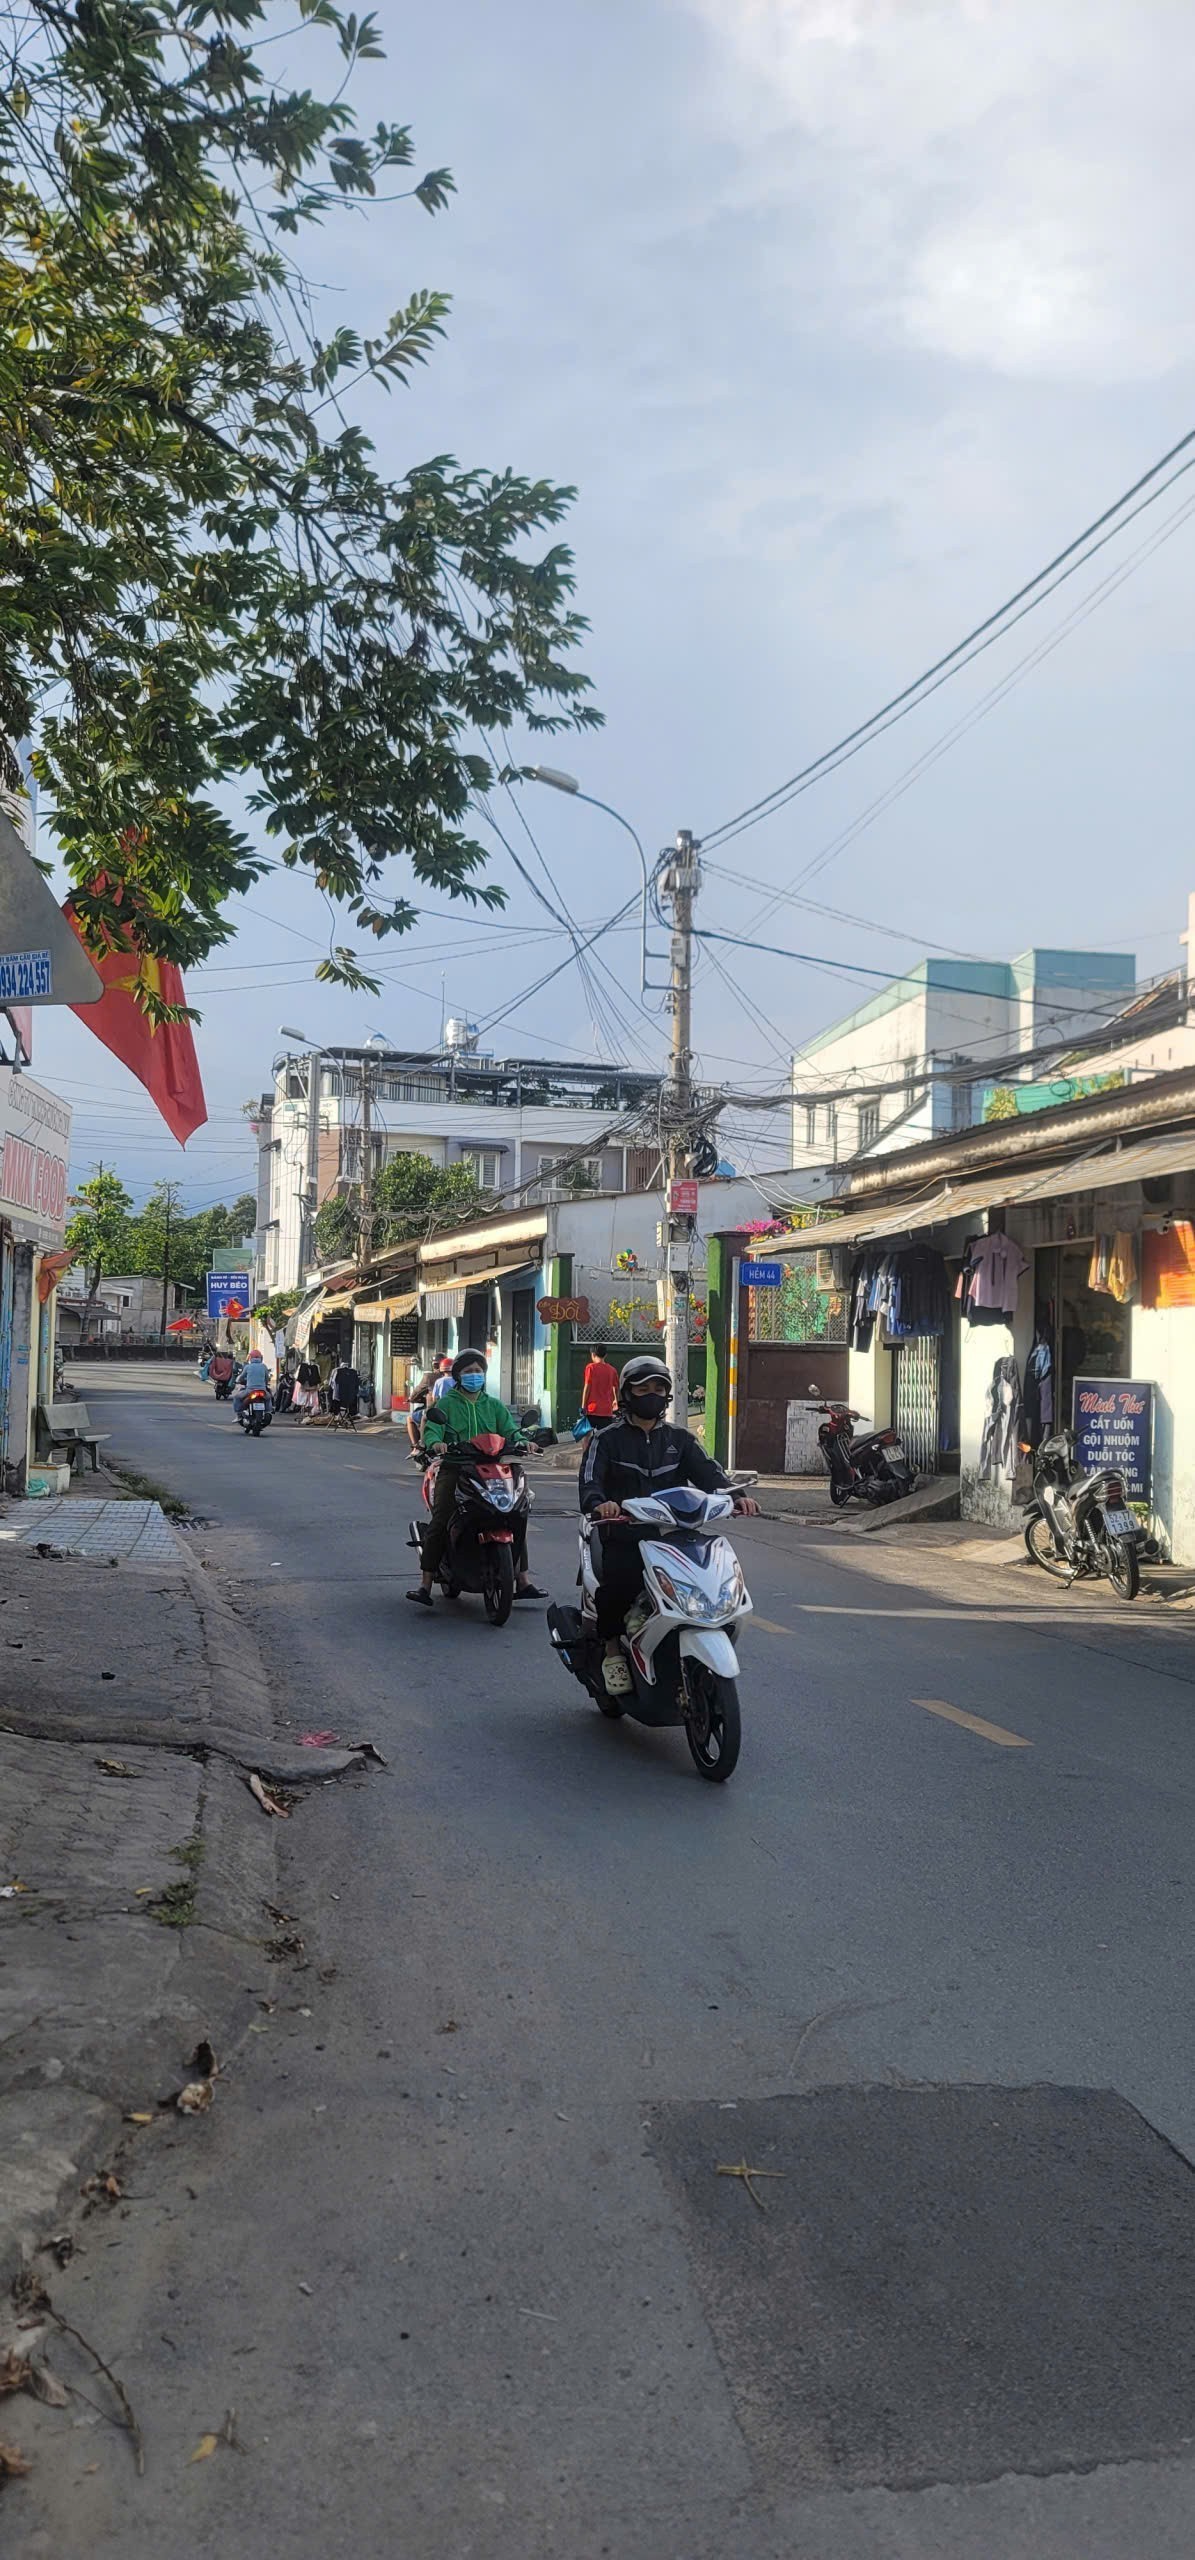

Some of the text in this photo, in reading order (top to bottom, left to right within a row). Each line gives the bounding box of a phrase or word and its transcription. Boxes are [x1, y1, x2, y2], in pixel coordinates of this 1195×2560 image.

[0, 961, 50, 997] 934.224.557
[33, 1146, 67, 1221] FOOD
[766, 1270, 776, 1280] 44
[230, 1280, 248, 1289] BÉO
[1079, 1392, 1145, 1415] Minh Thư
[1113, 1416, 1134, 1430] UỐN
[1083, 1432, 1140, 1448] GỘI NHUỘM
[1115, 1449, 1136, 1462] TÓC
[1111, 1520, 1135, 1532] 1399
